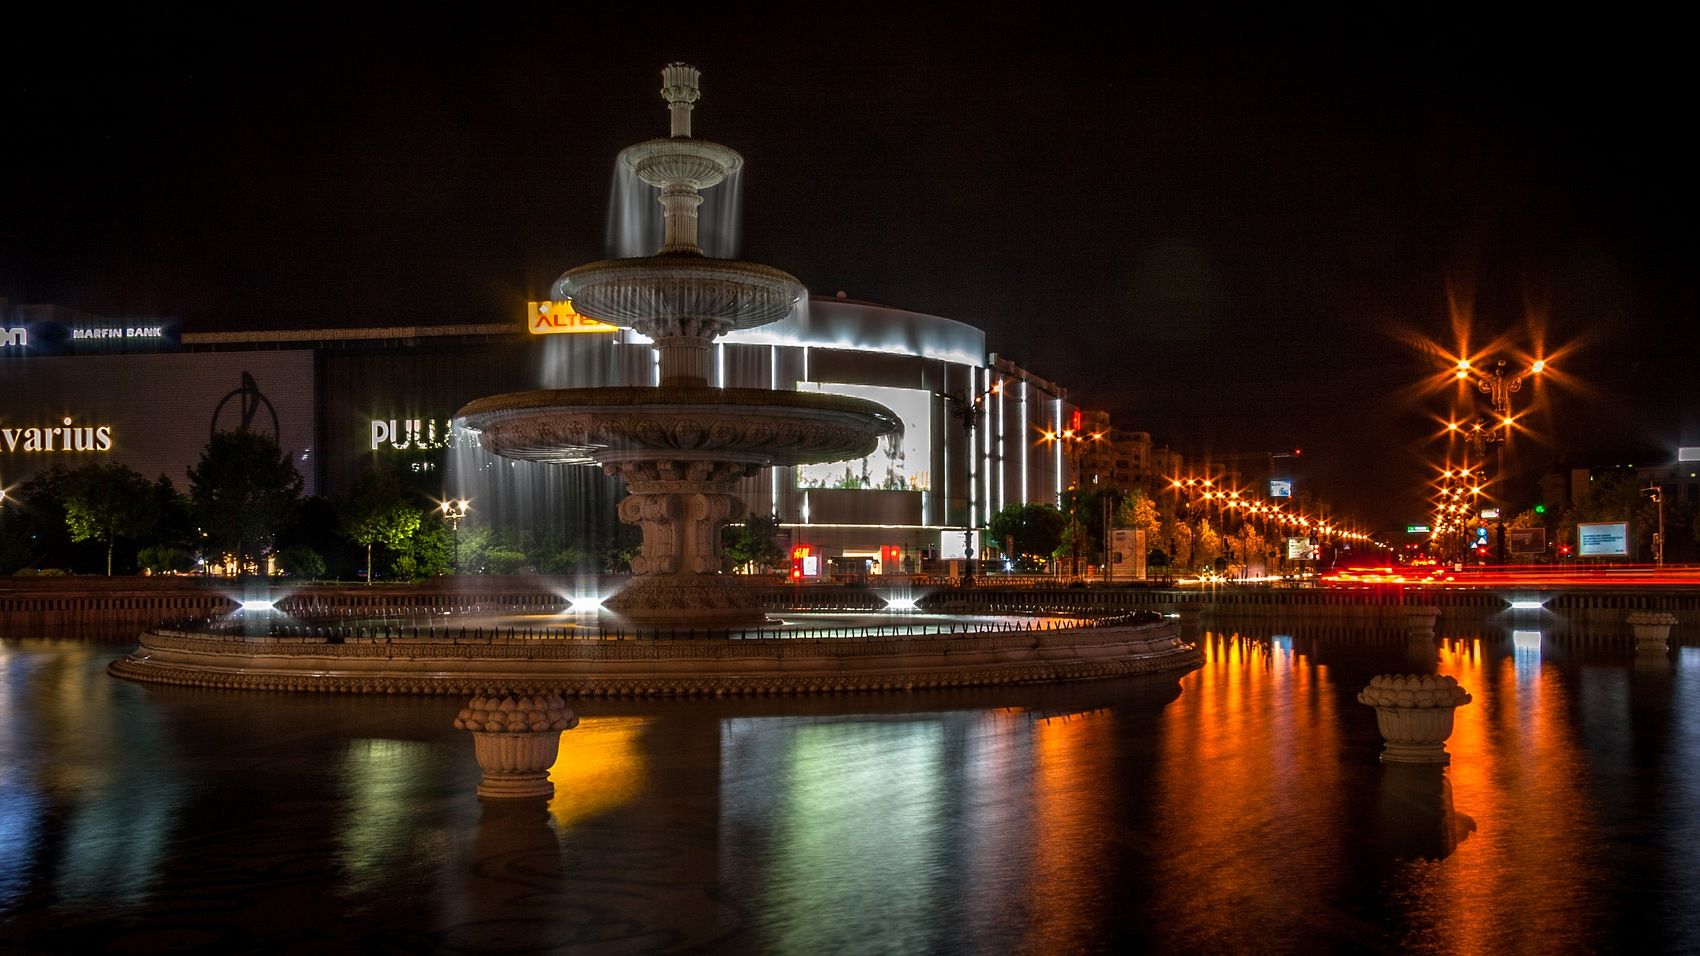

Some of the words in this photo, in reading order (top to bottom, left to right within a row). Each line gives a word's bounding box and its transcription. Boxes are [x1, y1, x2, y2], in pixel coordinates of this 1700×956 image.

[535, 313, 600, 328] ALTE
[73, 328, 123, 339] MARFIN
[126, 327, 163, 338] BANK
[0, 416, 112, 452] varius
